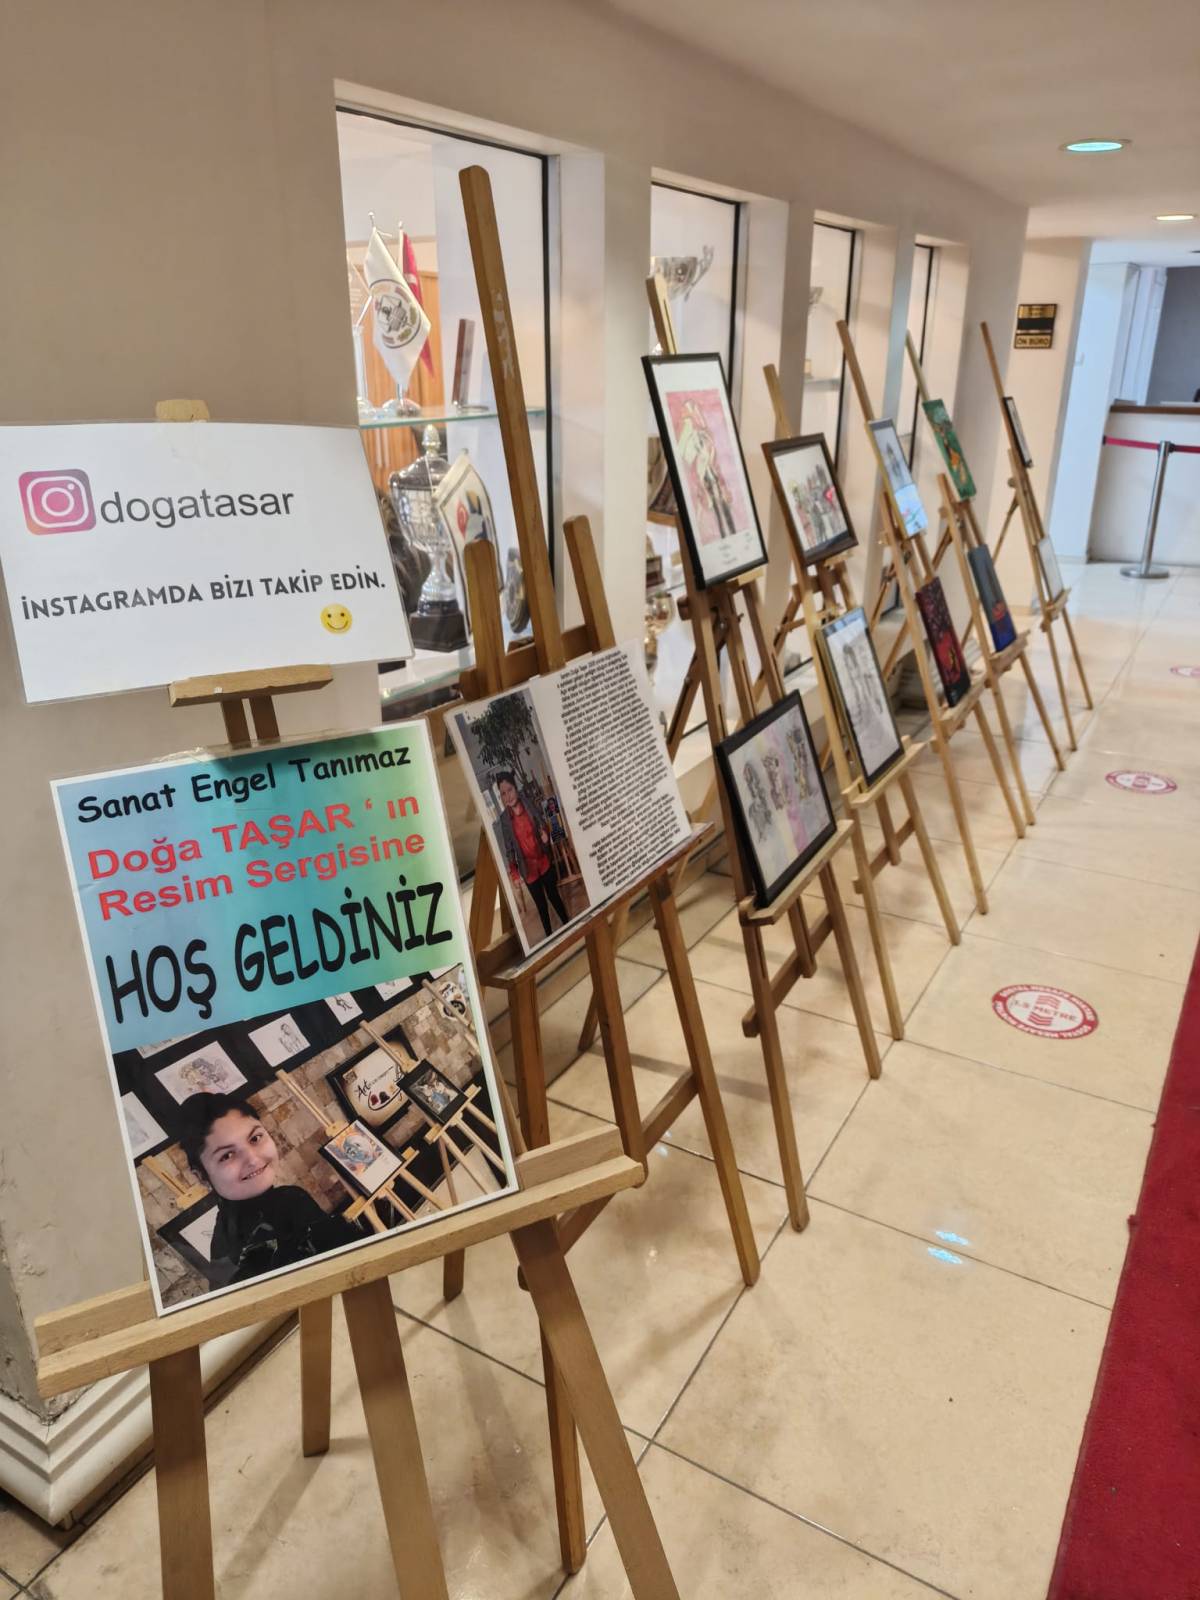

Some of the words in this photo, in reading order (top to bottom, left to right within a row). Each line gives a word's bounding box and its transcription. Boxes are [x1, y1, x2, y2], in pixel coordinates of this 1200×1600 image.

[100, 489, 294, 528] dogatasar
[21, 583, 204, 620] İNSTAGRAMDA
[209, 573, 254, 599] BİZI
[260, 568, 323, 596] TAKİP
[330, 564, 386, 591] EDİN.
[77, 783, 176, 824] Sanat
[190, 763, 277, 803] Engel
[288, 746, 411, 784] Tanımaz
[87, 836, 202, 881] Doğa
[212, 802, 355, 851] TAŞAR
[97, 872, 234, 921] Resim
[246, 832, 426, 889] Sergisine
[105, 939, 217, 1024] HOŞ
[234, 874, 453, 993] GELDİNİZ
